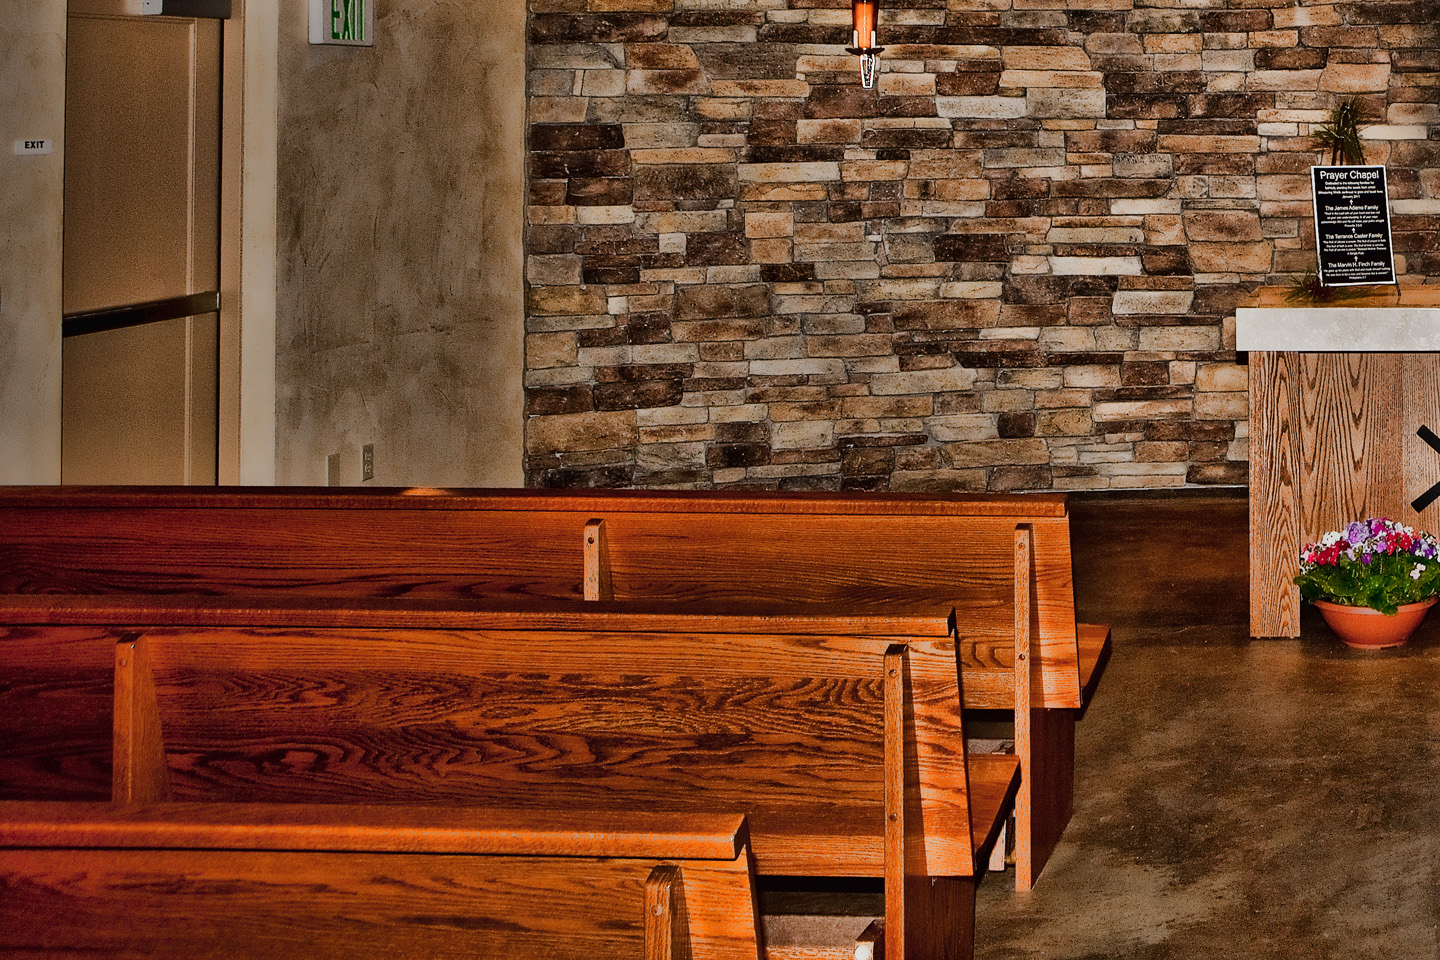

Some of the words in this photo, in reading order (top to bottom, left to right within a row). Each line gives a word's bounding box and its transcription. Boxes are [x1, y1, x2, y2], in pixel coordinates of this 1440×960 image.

[24, 140, 45, 149] EXIT
[1320, 170, 1348, 182] Prayer
[1349, 169, 1380, 181] Chapel
